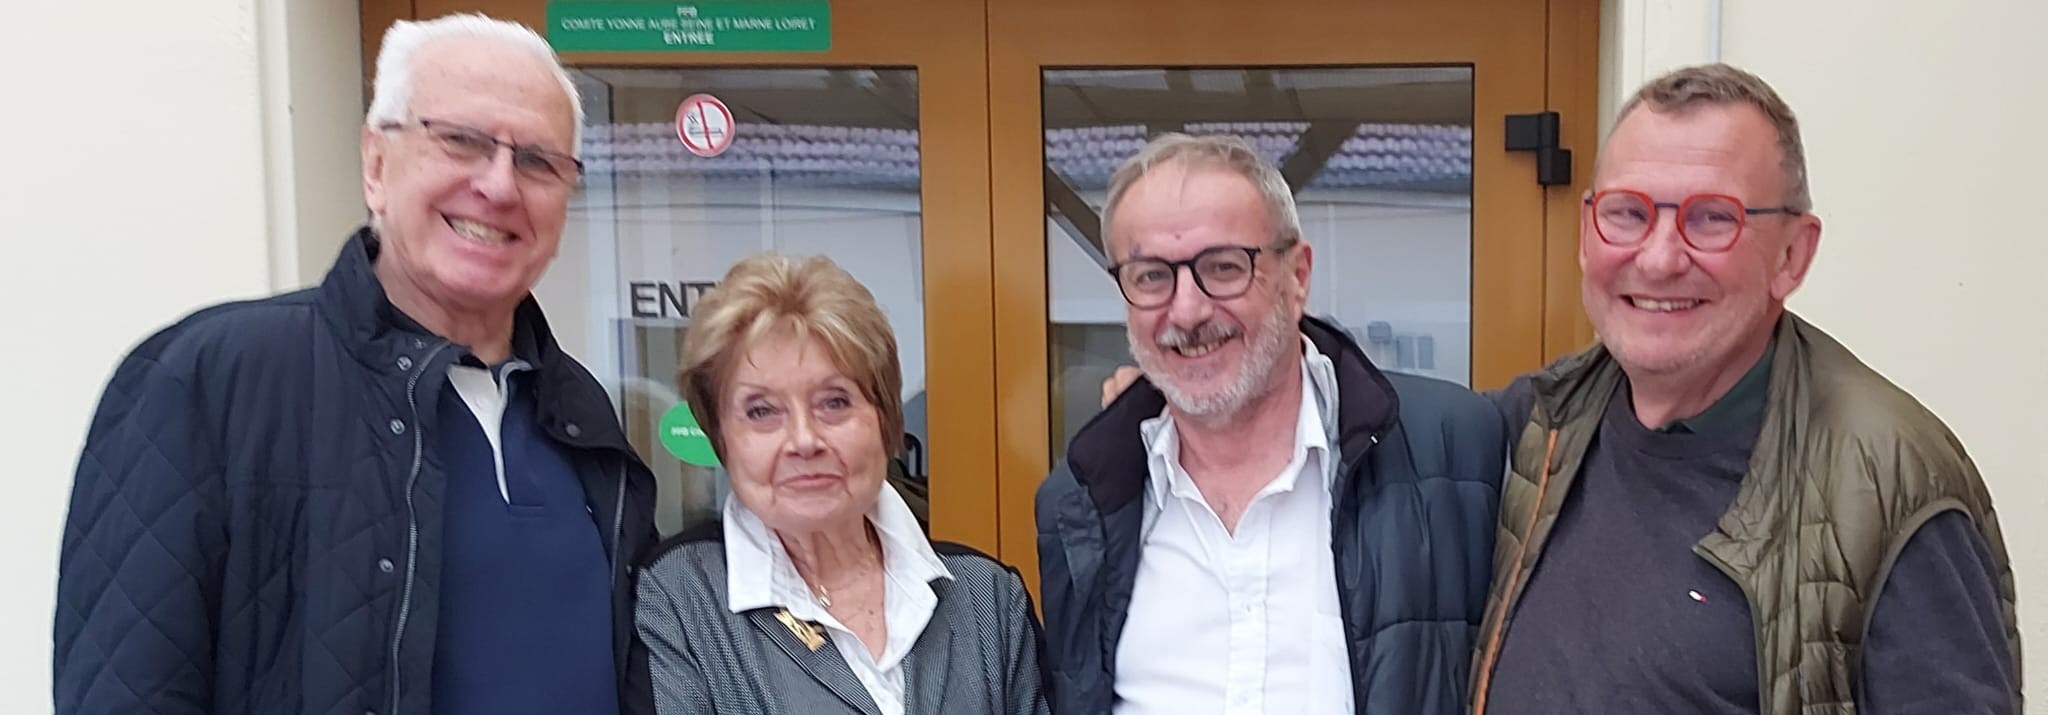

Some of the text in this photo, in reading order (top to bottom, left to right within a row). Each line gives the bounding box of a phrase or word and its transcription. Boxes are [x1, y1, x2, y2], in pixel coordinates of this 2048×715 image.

[606, 17, 645, 31] YONNE
[715, 17, 730, 31] ET
[732, 17, 773, 31] MARNE
[774, 17, 816, 31] LOIRET
[630, 281, 720, 318] ENT
